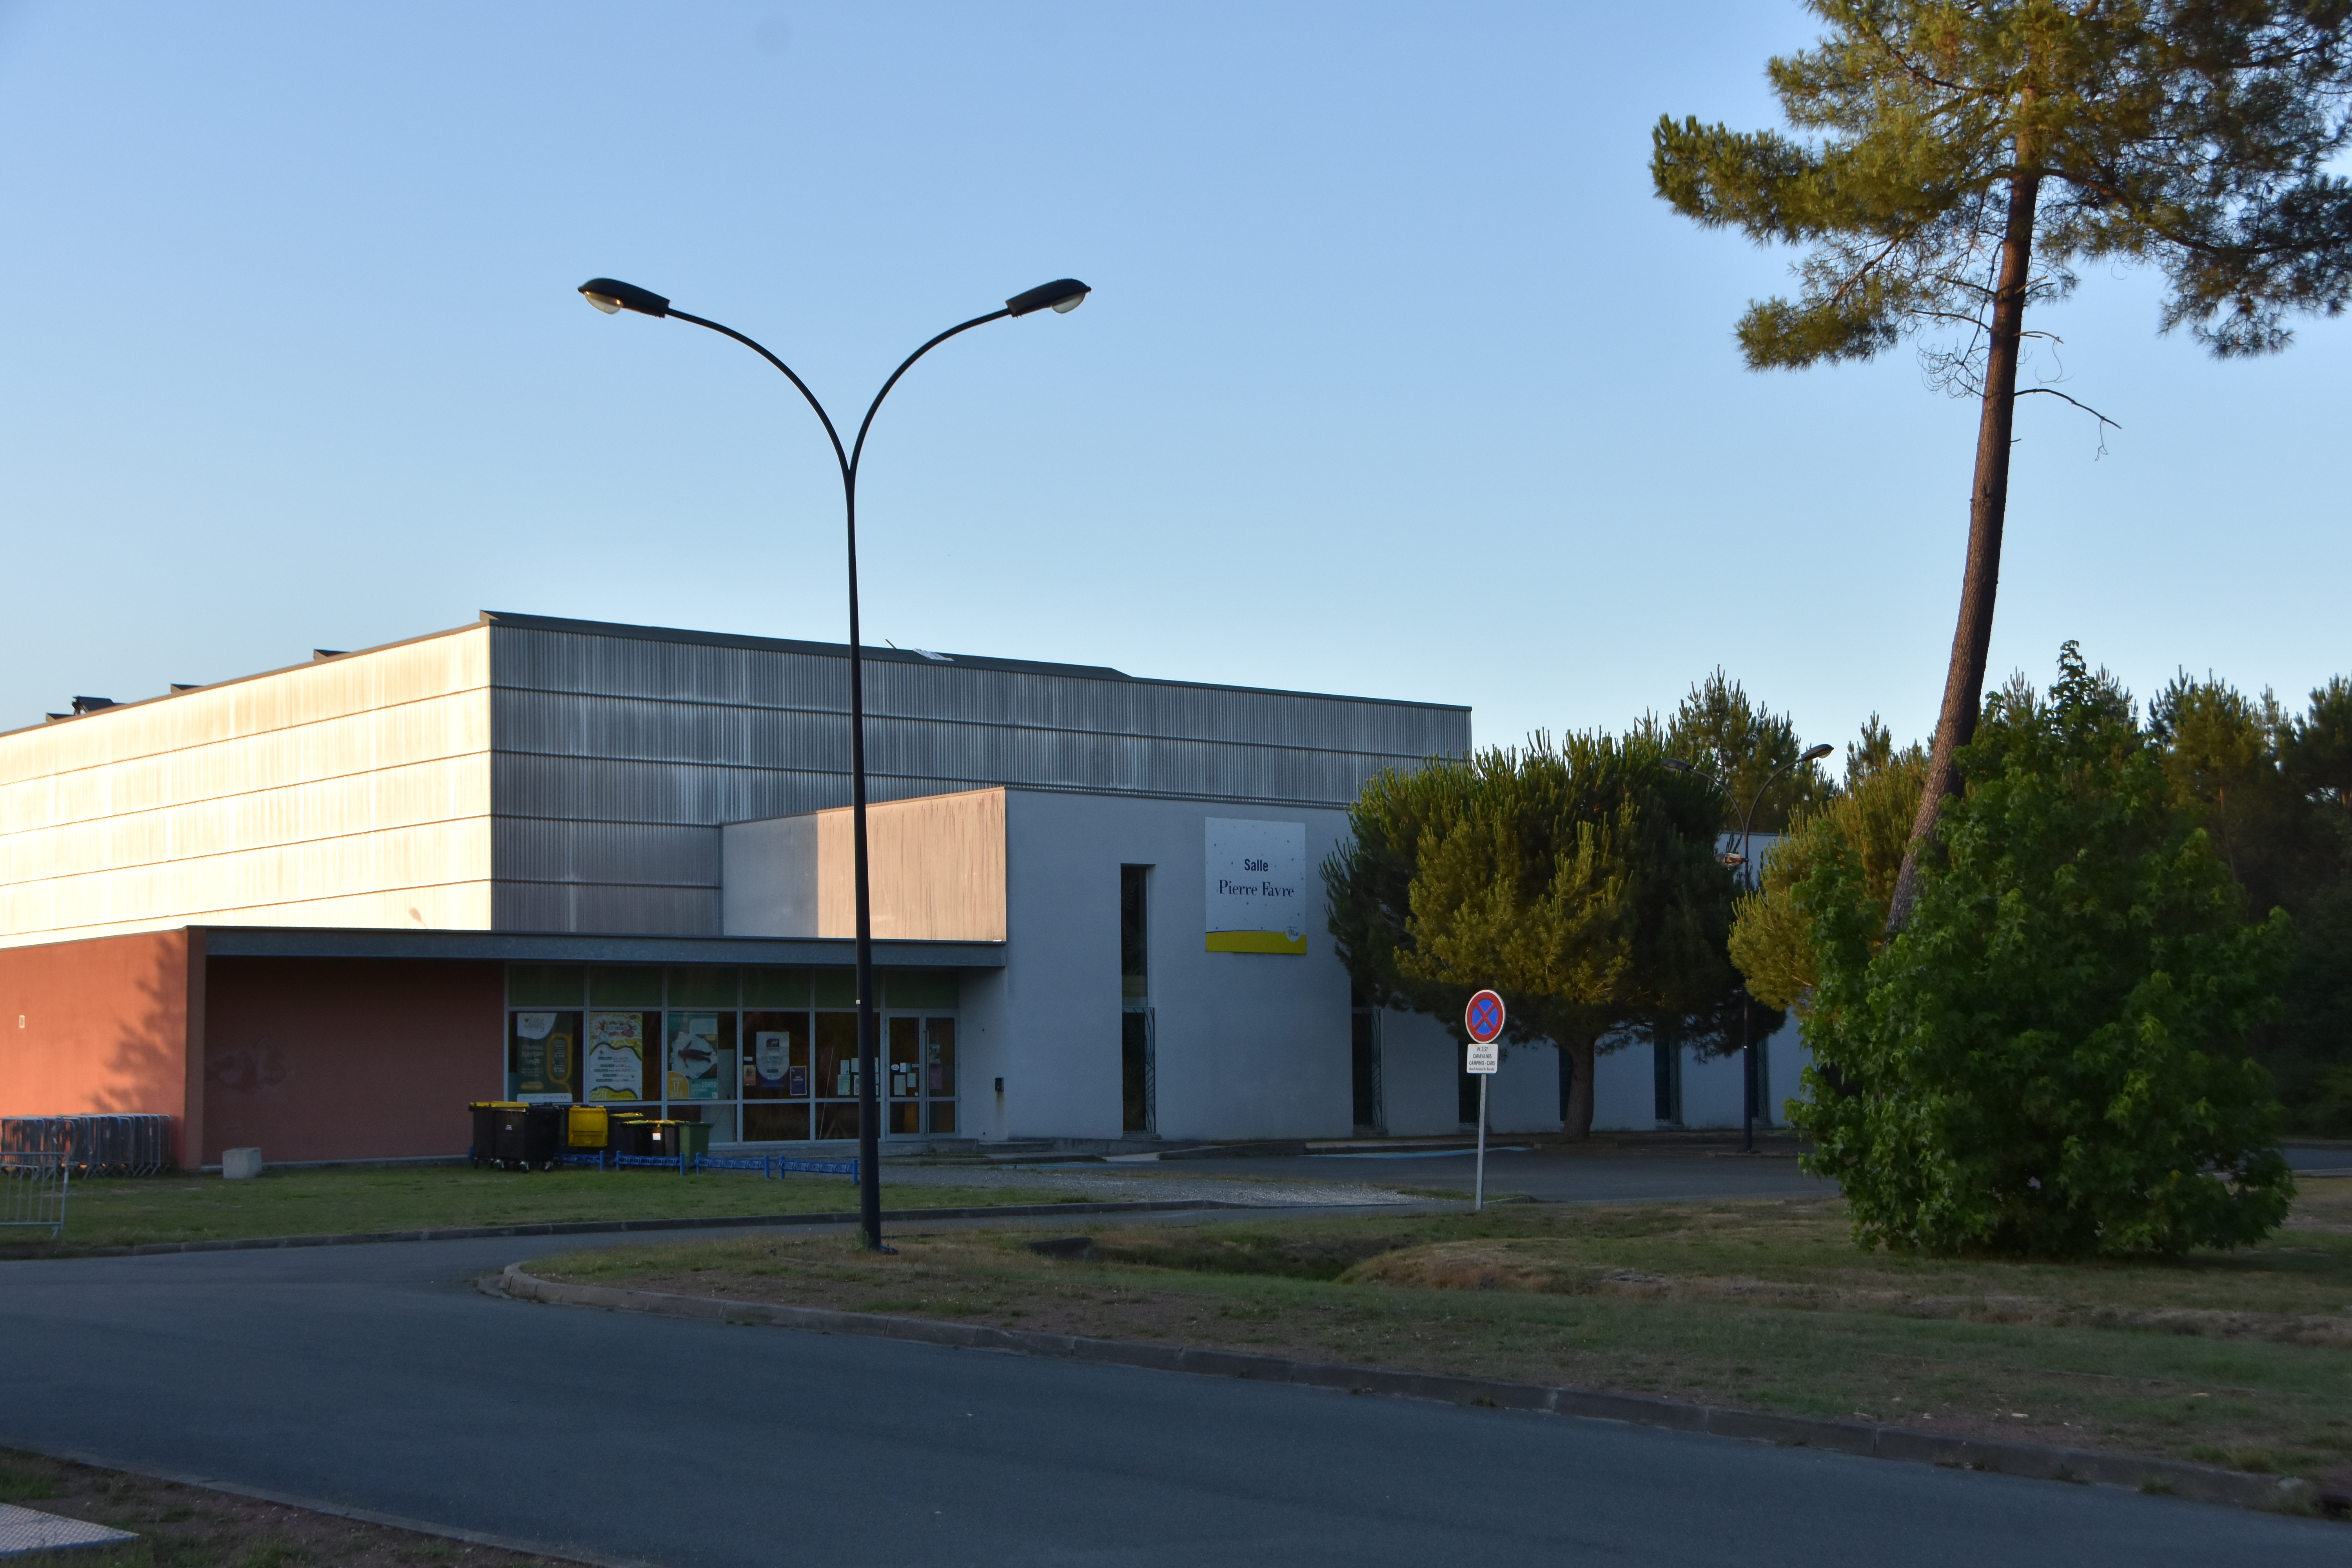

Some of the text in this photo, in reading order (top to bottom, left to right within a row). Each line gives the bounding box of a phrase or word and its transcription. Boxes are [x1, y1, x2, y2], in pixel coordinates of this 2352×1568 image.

[1244, 858, 1269, 872] Salle
[1218, 879, 1294, 897] Pierre Favre
[673, 1082, 680, 1091] 17
